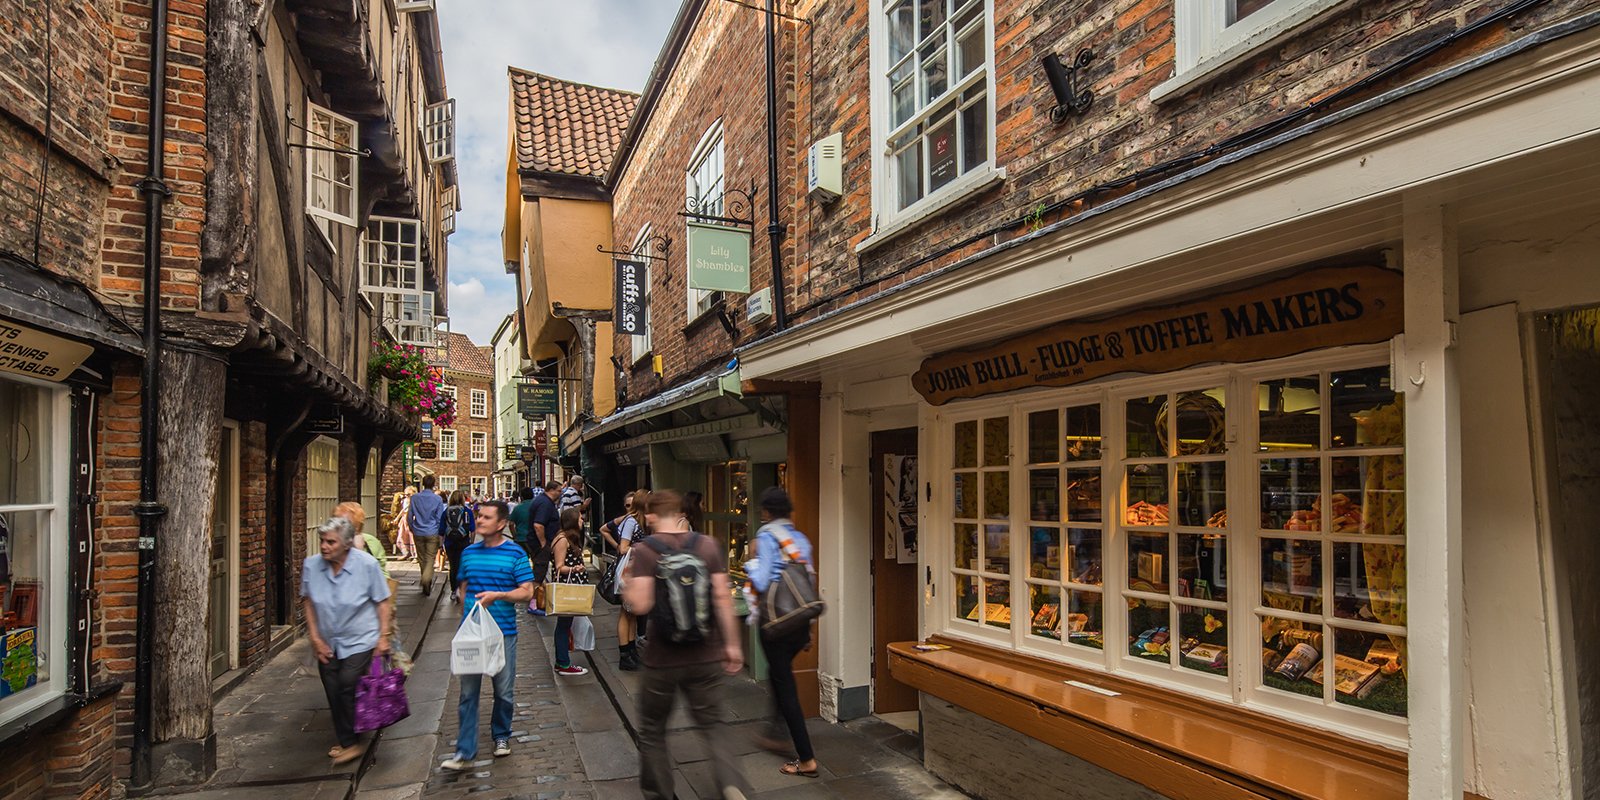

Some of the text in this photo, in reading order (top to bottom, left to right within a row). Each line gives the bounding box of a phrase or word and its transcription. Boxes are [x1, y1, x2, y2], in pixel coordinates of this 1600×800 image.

[695, 257, 745, 273] Shambles
[710, 245, 730, 259] Lily
[626, 264, 640, 331] cuffs&co
[928, 365, 972, 394] JOHN
[972, 352, 1029, 385] BULL
[1037, 334, 1104, 371] FUDGE
[1105, 331, 1124, 359] &
[1125, 312, 1214, 355] TOFFEE
[1220, 282, 1364, 340] MAKERS
